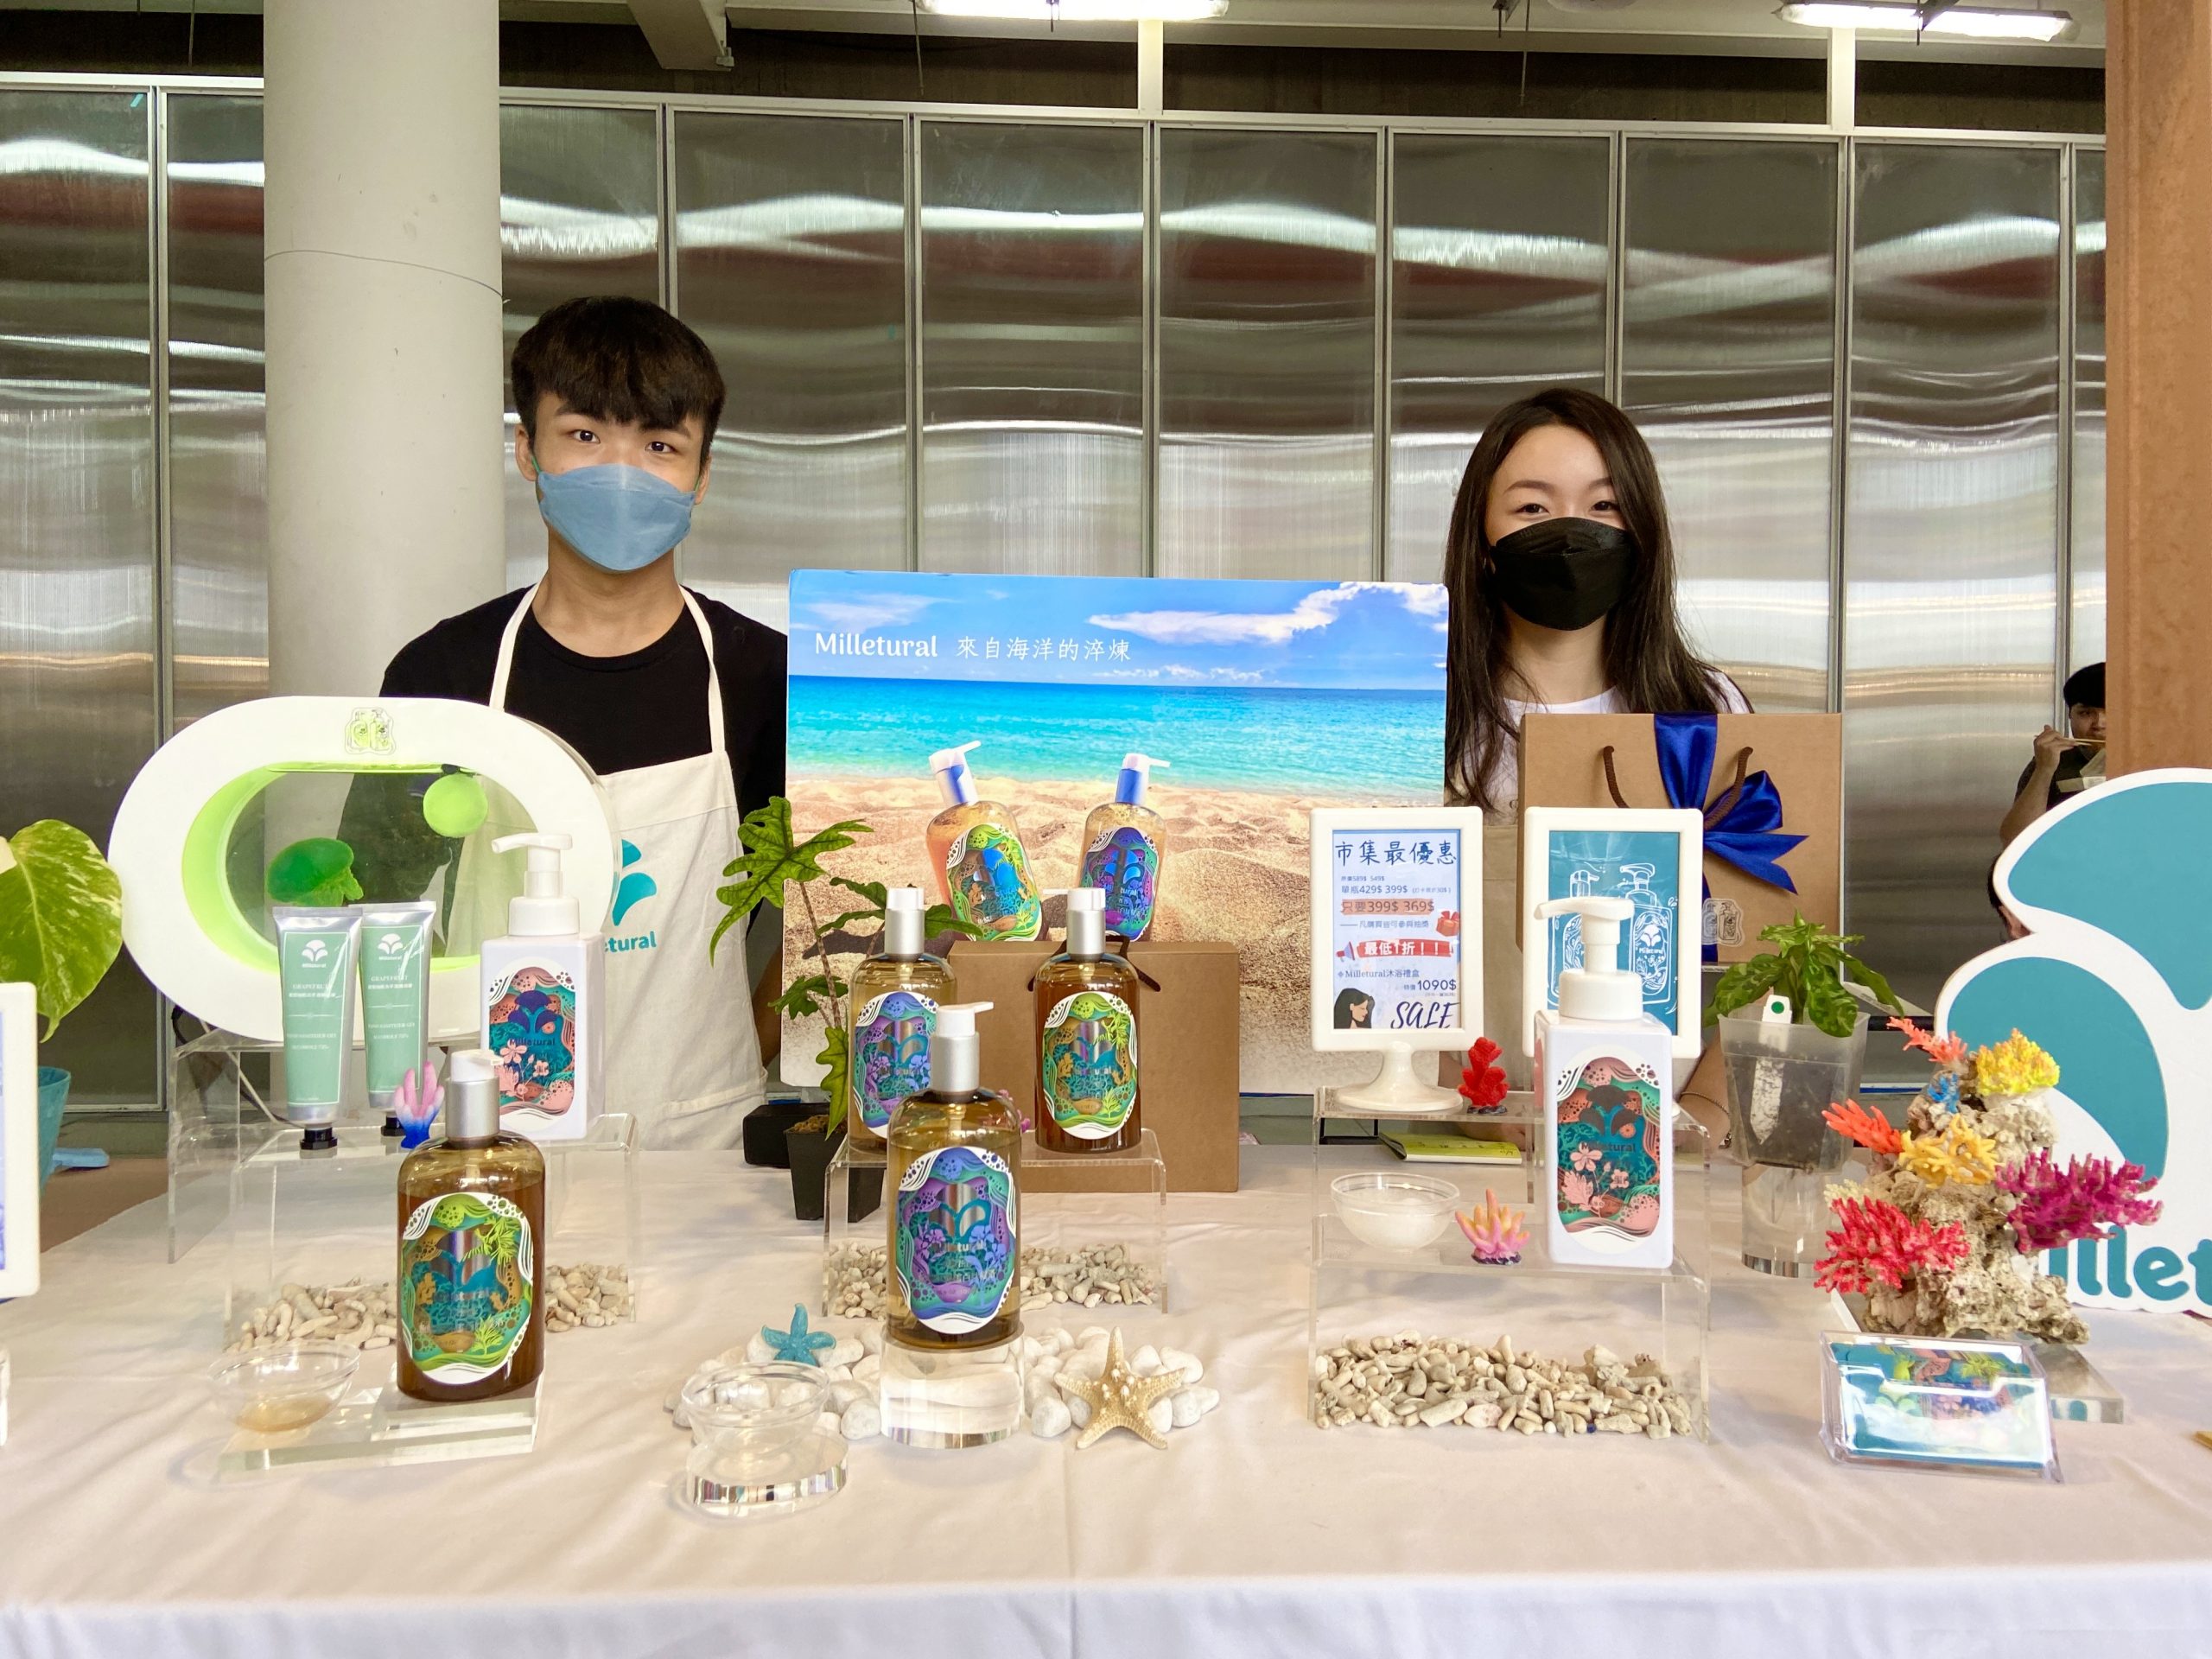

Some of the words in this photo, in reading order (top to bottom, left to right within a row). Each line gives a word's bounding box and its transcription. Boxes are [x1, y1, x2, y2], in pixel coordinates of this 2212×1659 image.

[816, 632, 938, 658] Milletural
[956, 636, 1132, 662] 來自海洋的淬煉
[1335, 840, 1457, 867] 市集最優惠
[1385, 885, 1408, 893] 399$
[1403, 900, 1434, 912] 369$
[605, 931, 657, 953] tural
[1417, 979, 1457, 990] 1090$
